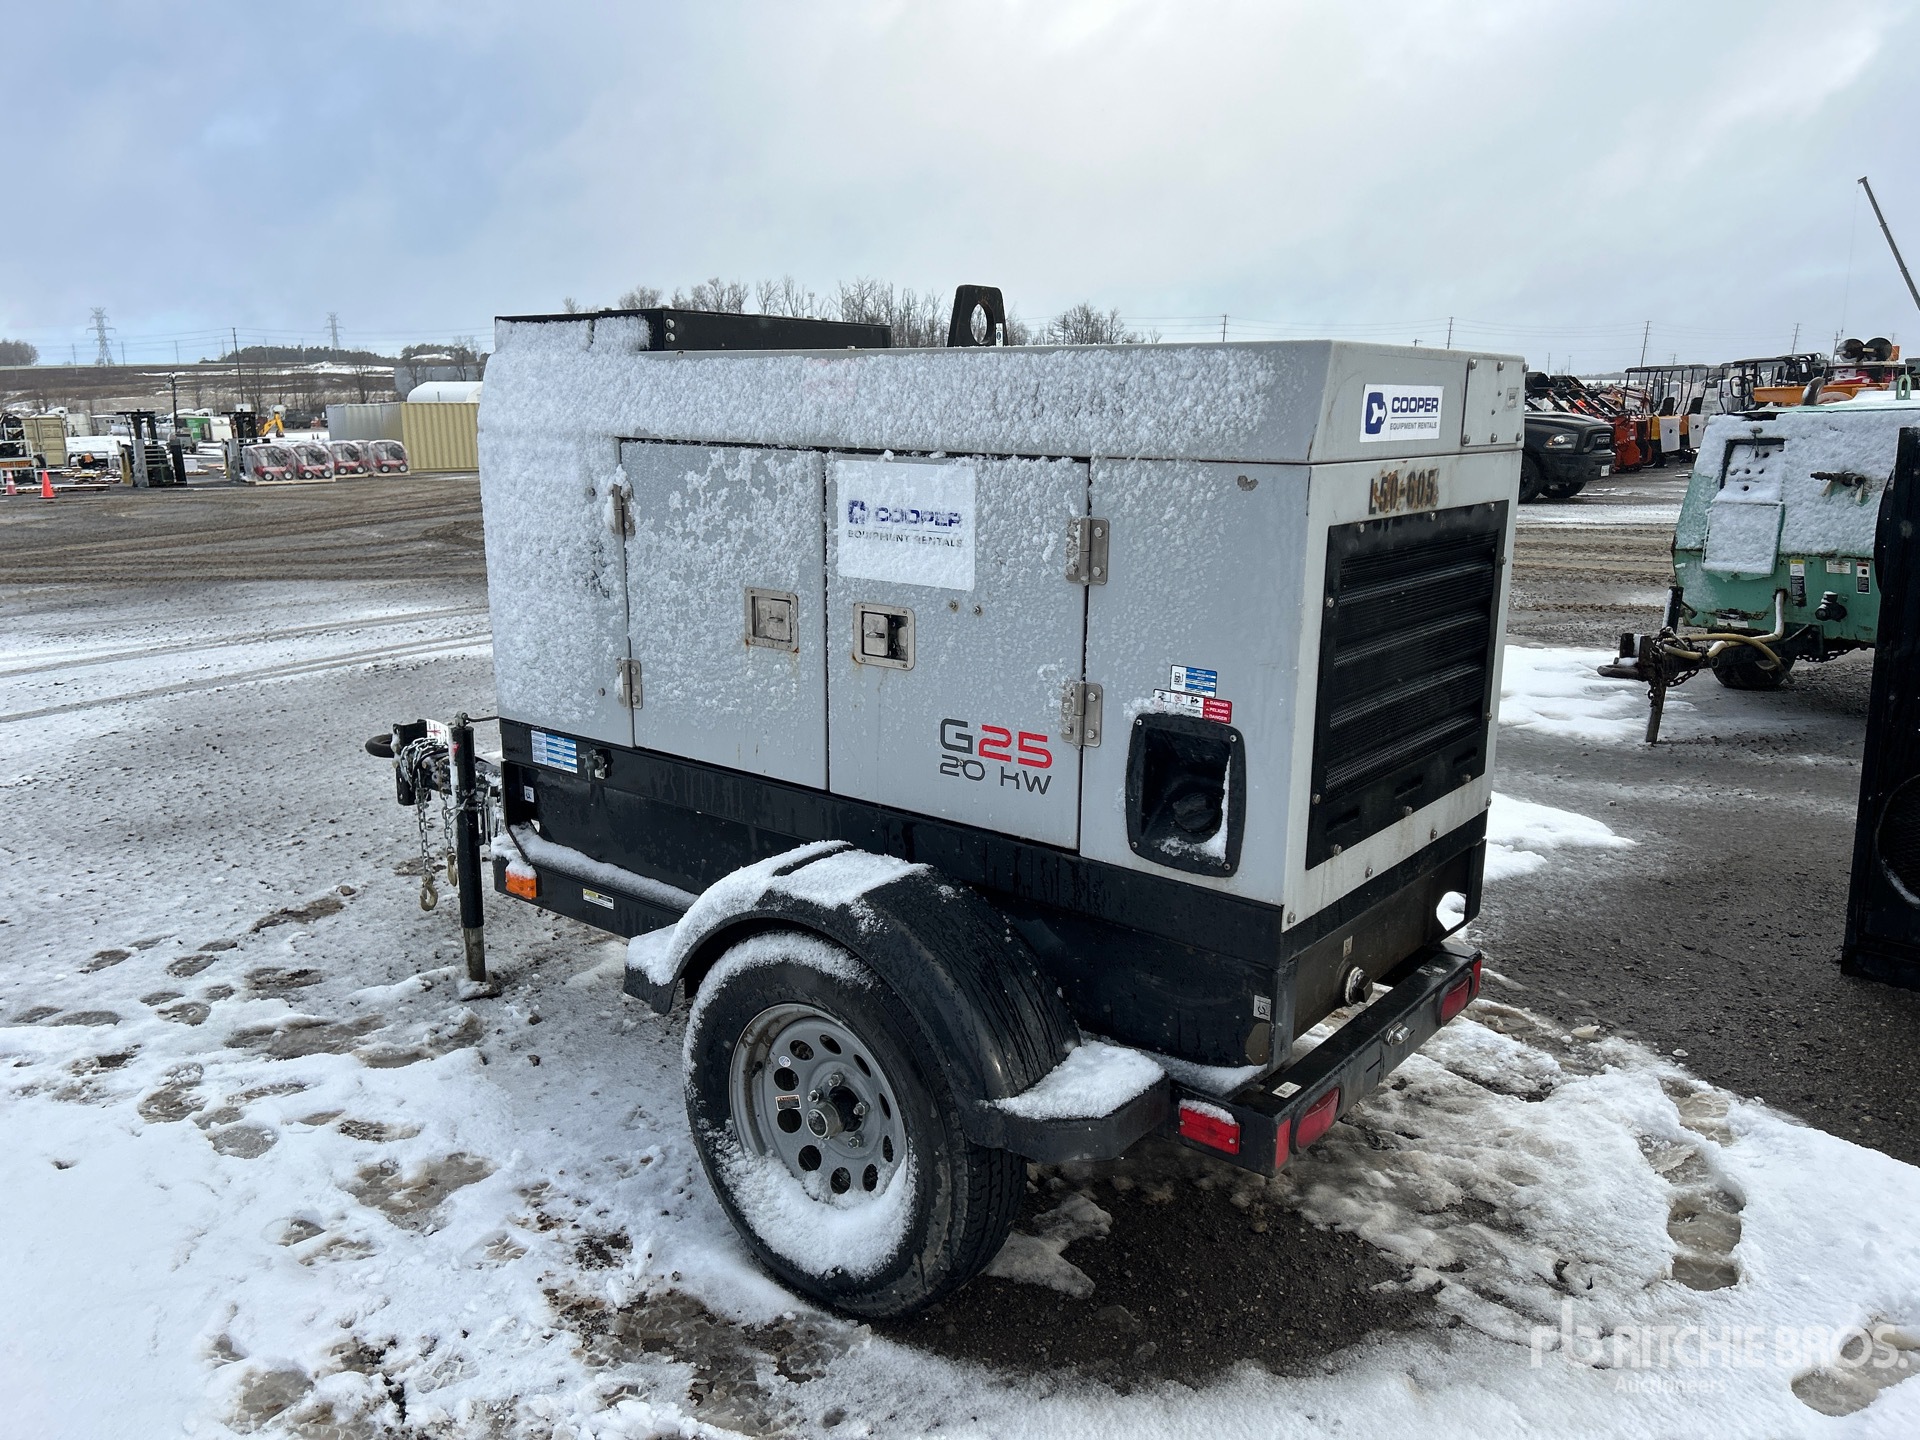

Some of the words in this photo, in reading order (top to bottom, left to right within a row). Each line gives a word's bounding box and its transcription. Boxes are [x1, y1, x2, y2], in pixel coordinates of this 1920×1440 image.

[1392, 397, 1439, 413] COOPER
[1390, 422, 1417, 431] EQUIPMENT
[1417, 421, 1437, 430] RENTALS
[940, 718, 1053, 769] G25
[940, 754, 985, 781] 20
